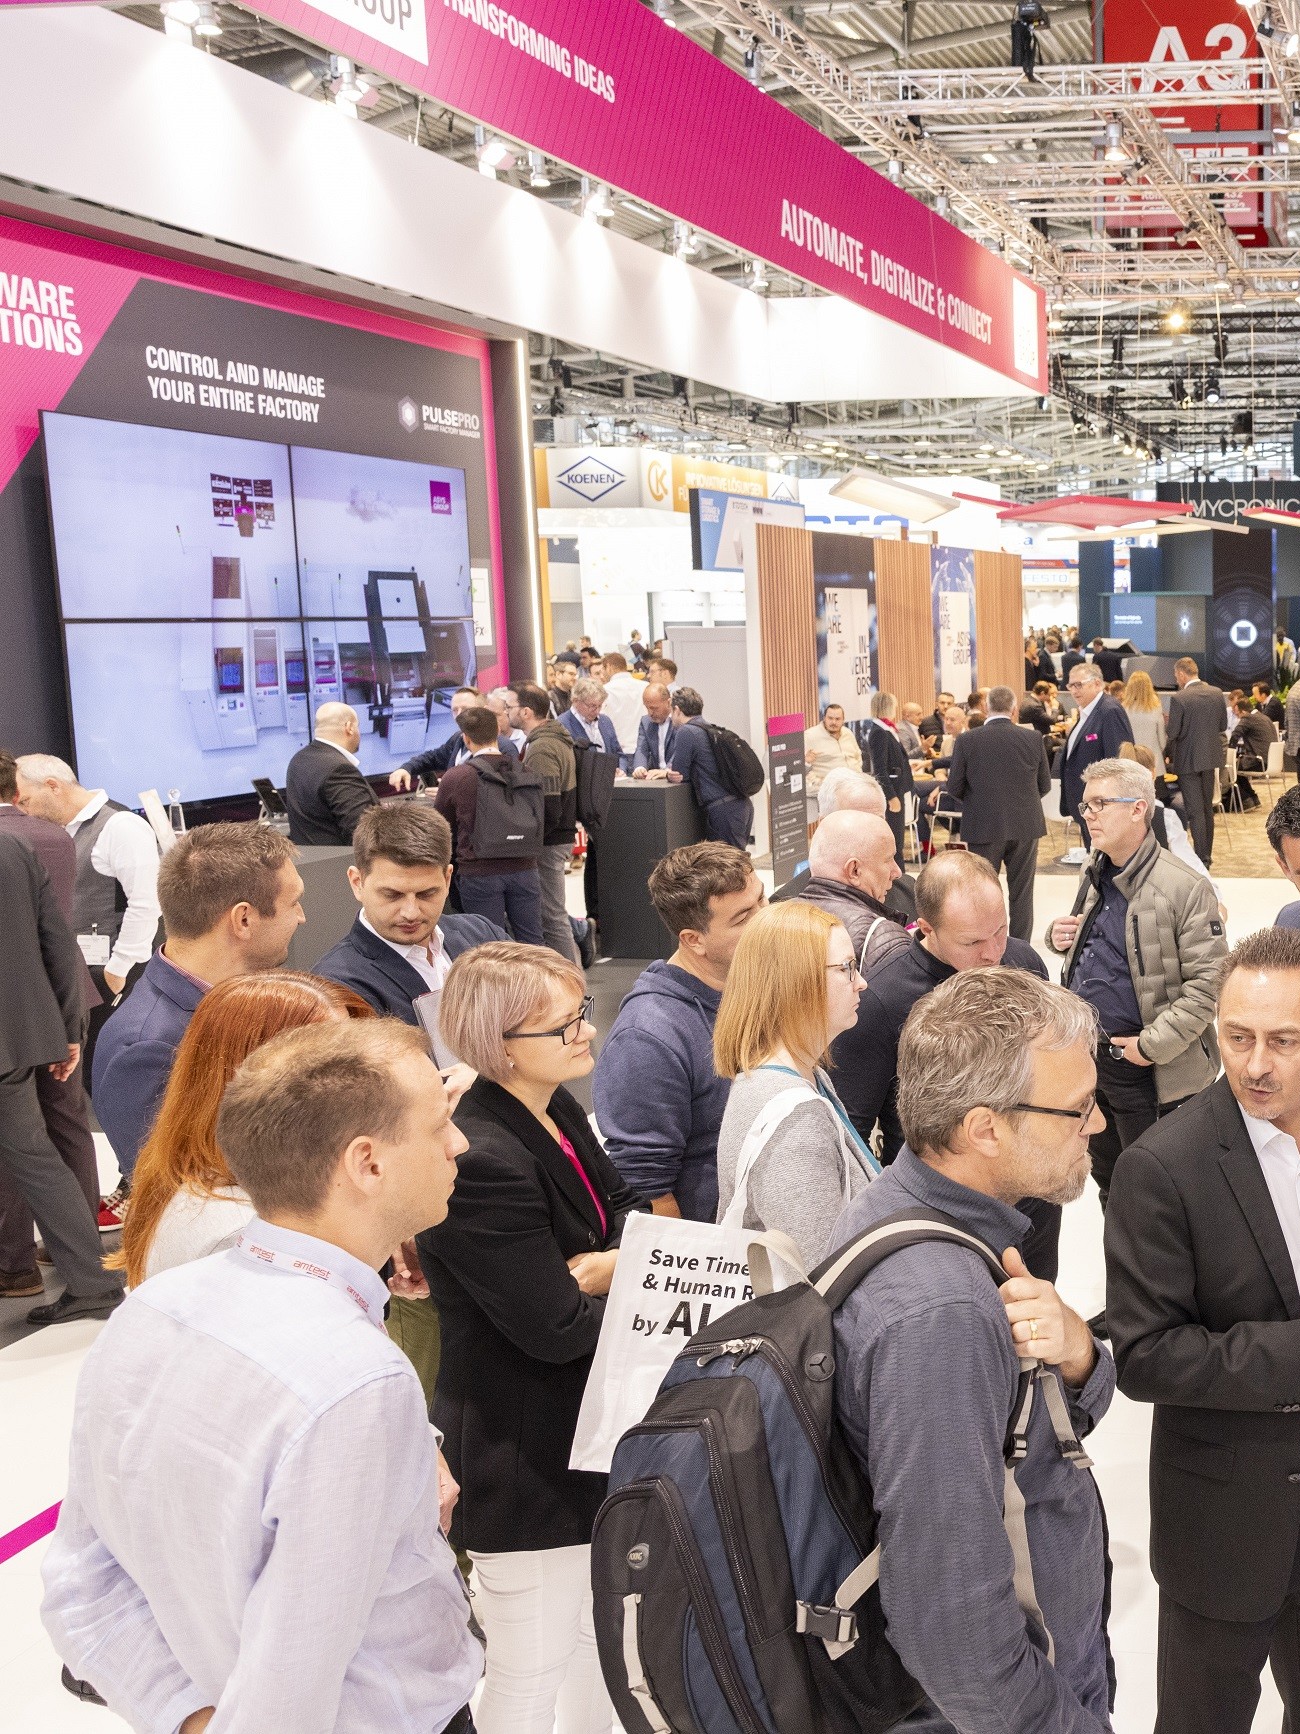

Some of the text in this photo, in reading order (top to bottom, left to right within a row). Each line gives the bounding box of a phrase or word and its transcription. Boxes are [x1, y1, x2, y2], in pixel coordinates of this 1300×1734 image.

[1139, 23, 1247, 93] A3
[573, 55, 616, 104] IDEAS
[780, 198, 992, 345] AUTOMATE, DIGITALIZE & CONNECT
[145, 345, 326, 399] CONTROL AND MANAGE
[147, 375, 320, 424] YOUR ENTIRE FACTORY
[422, 405, 479, 430] PULSEPRO
[567, 473, 615, 484] KOENEN
[1024, 574, 1068, 583] FESTO
[250, 1244, 276, 1261] amtest
[648, 1248, 750, 1276] Save Time
[293, 1259, 332, 1279] amtest
[346, 1285, 371, 1312] amtest
[642, 1273, 659, 1291] &
[664, 1276, 736, 1299] Human
[631, 1314, 659, 1337] by
